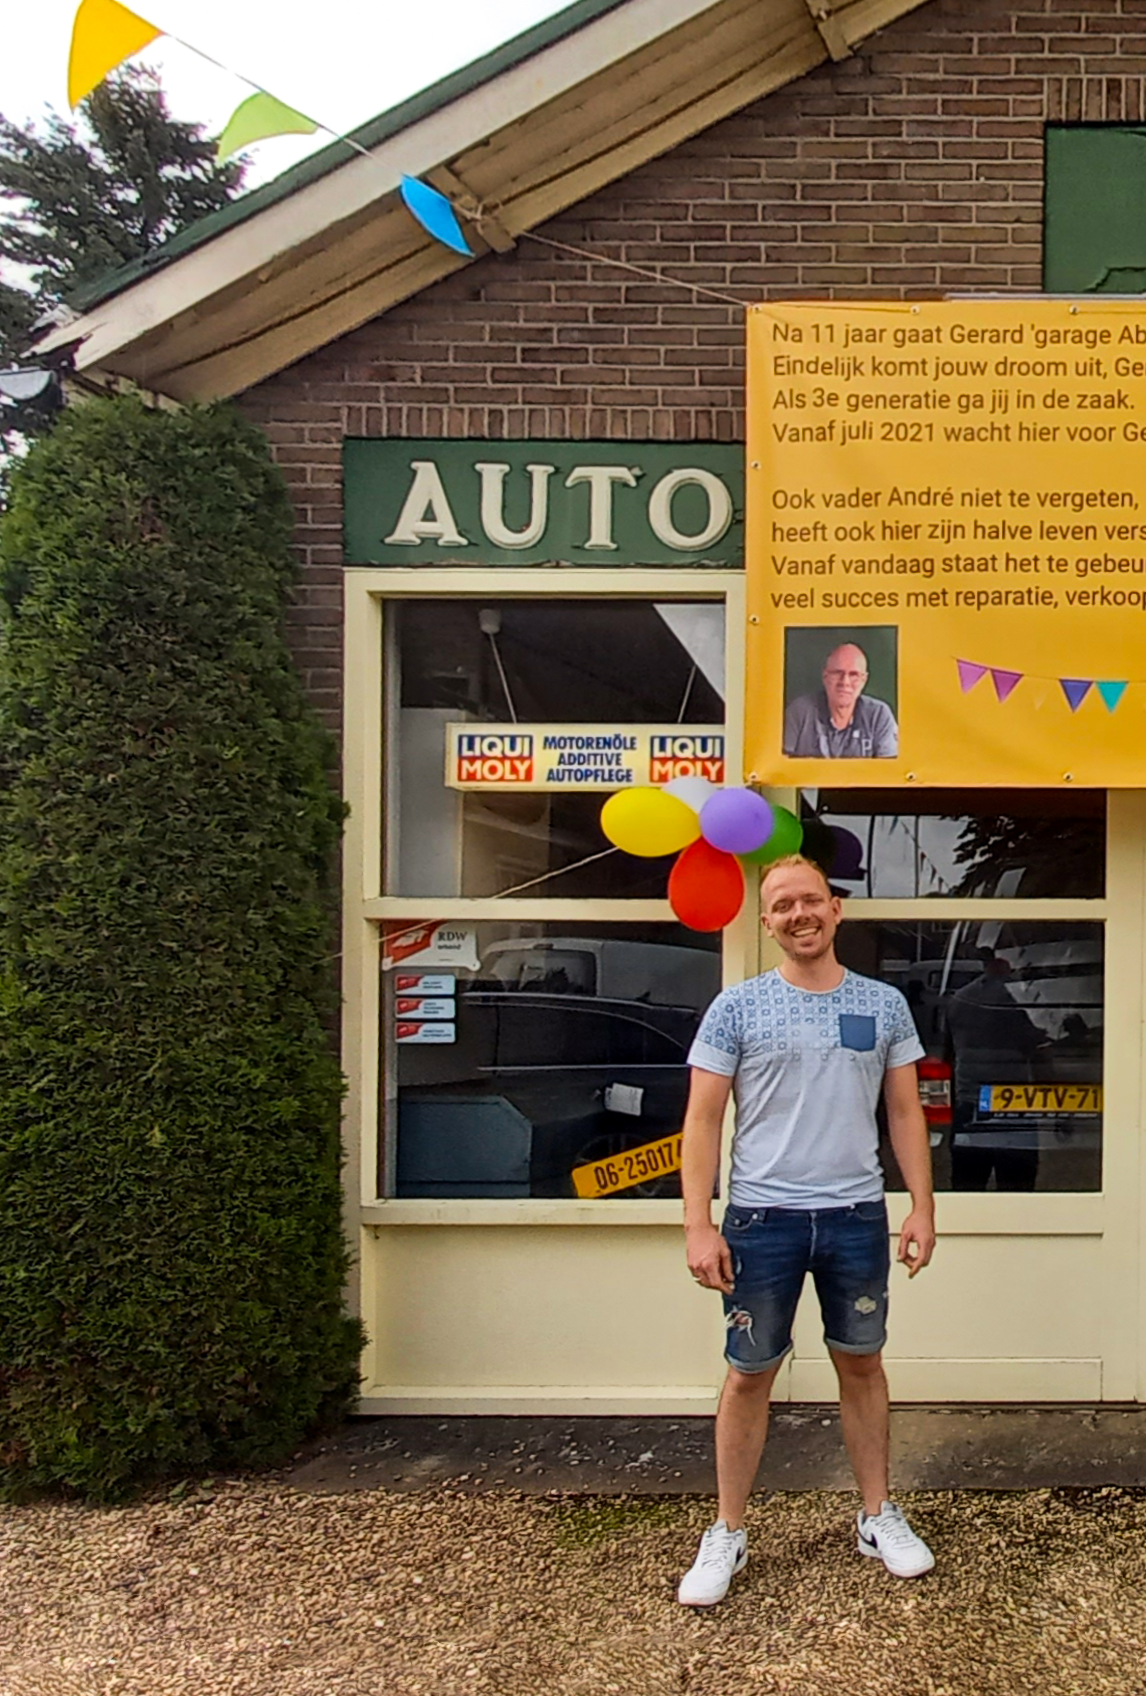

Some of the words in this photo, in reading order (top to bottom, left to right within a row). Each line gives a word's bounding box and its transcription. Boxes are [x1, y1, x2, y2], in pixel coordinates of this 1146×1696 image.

[772, 322, 803, 344] Na
[810, 323, 835, 344] 11
[842, 323, 888, 349] jaar
[892, 325, 943, 349] gaat
[949, 323, 1024, 345] Gerard
[1030, 323, 1112, 350] 'garage
[773, 354, 865, 382] Eindelijk
[871, 355, 929, 377] komt
[932, 356, 989, 382] jouw
[994, 355, 1068, 377] droom
[1074, 356, 1108, 380] uit,
[772, 388, 807, 410] Als
[812, 387, 840, 408] 3e
[846, 388, 952, 413] generatie
[957, 393, 985, 415] ga
[989, 388, 1009, 415] jij
[1016, 388, 1036, 410] in
[1042, 388, 1070, 410] de
[1076, 388, 1135, 410] zaak.
[771, 419, 837, 443] Vanaf
[839, 419, 874, 447] juli
[880, 421, 934, 443] 2021
[943, 420, 1012, 443] wacht
[1018, 421, 1061, 442] hier
[1065, 426, 1117, 443] voor
[384, 461, 733, 552] AUTO
[771, 487, 816, 510] Ook
[821, 486, 883, 509] vader
[887, 486, 954, 507] André
[960, 487, 1003, 508] niet
[1007, 489, 1031, 508] te
[1036, 488, 1139, 513] vergeten,
[771, 520, 828, 543] heeft
[833, 520, 876, 542] ook
[881, 519, 923, 541] hier
[927, 518, 966, 545] zijn
[973, 518, 1033, 541] halve
[1039, 519, 1098, 541] leven
[770, 553, 837, 576] Vanaf
[841, 553, 935, 579] vandaag
[941, 553, 999, 574] staat
[1004, 551, 1041, 574] het
[1045, 554, 1069, 574] te
[770, 587, 815, 609] veel
[821, 591, 900, 609] succes
[906, 587, 949, 608] met
[954, 585, 1059, 612] reparatie,
[460, 736, 531, 758] LIQUI
[543, 733, 637, 750] MOTORENÖLE
[653, 737, 721, 759] LIQUI
[461, 759, 532, 781] MOLY
[557, 753, 623, 767] ADDITIVE
[652, 760, 722, 782] MOLY
[546, 768, 633, 783] AUTOPFLEGE
[437, 931, 468, 942] RDW
[1000, 1087, 1099, 1109] 9-VTV-71
